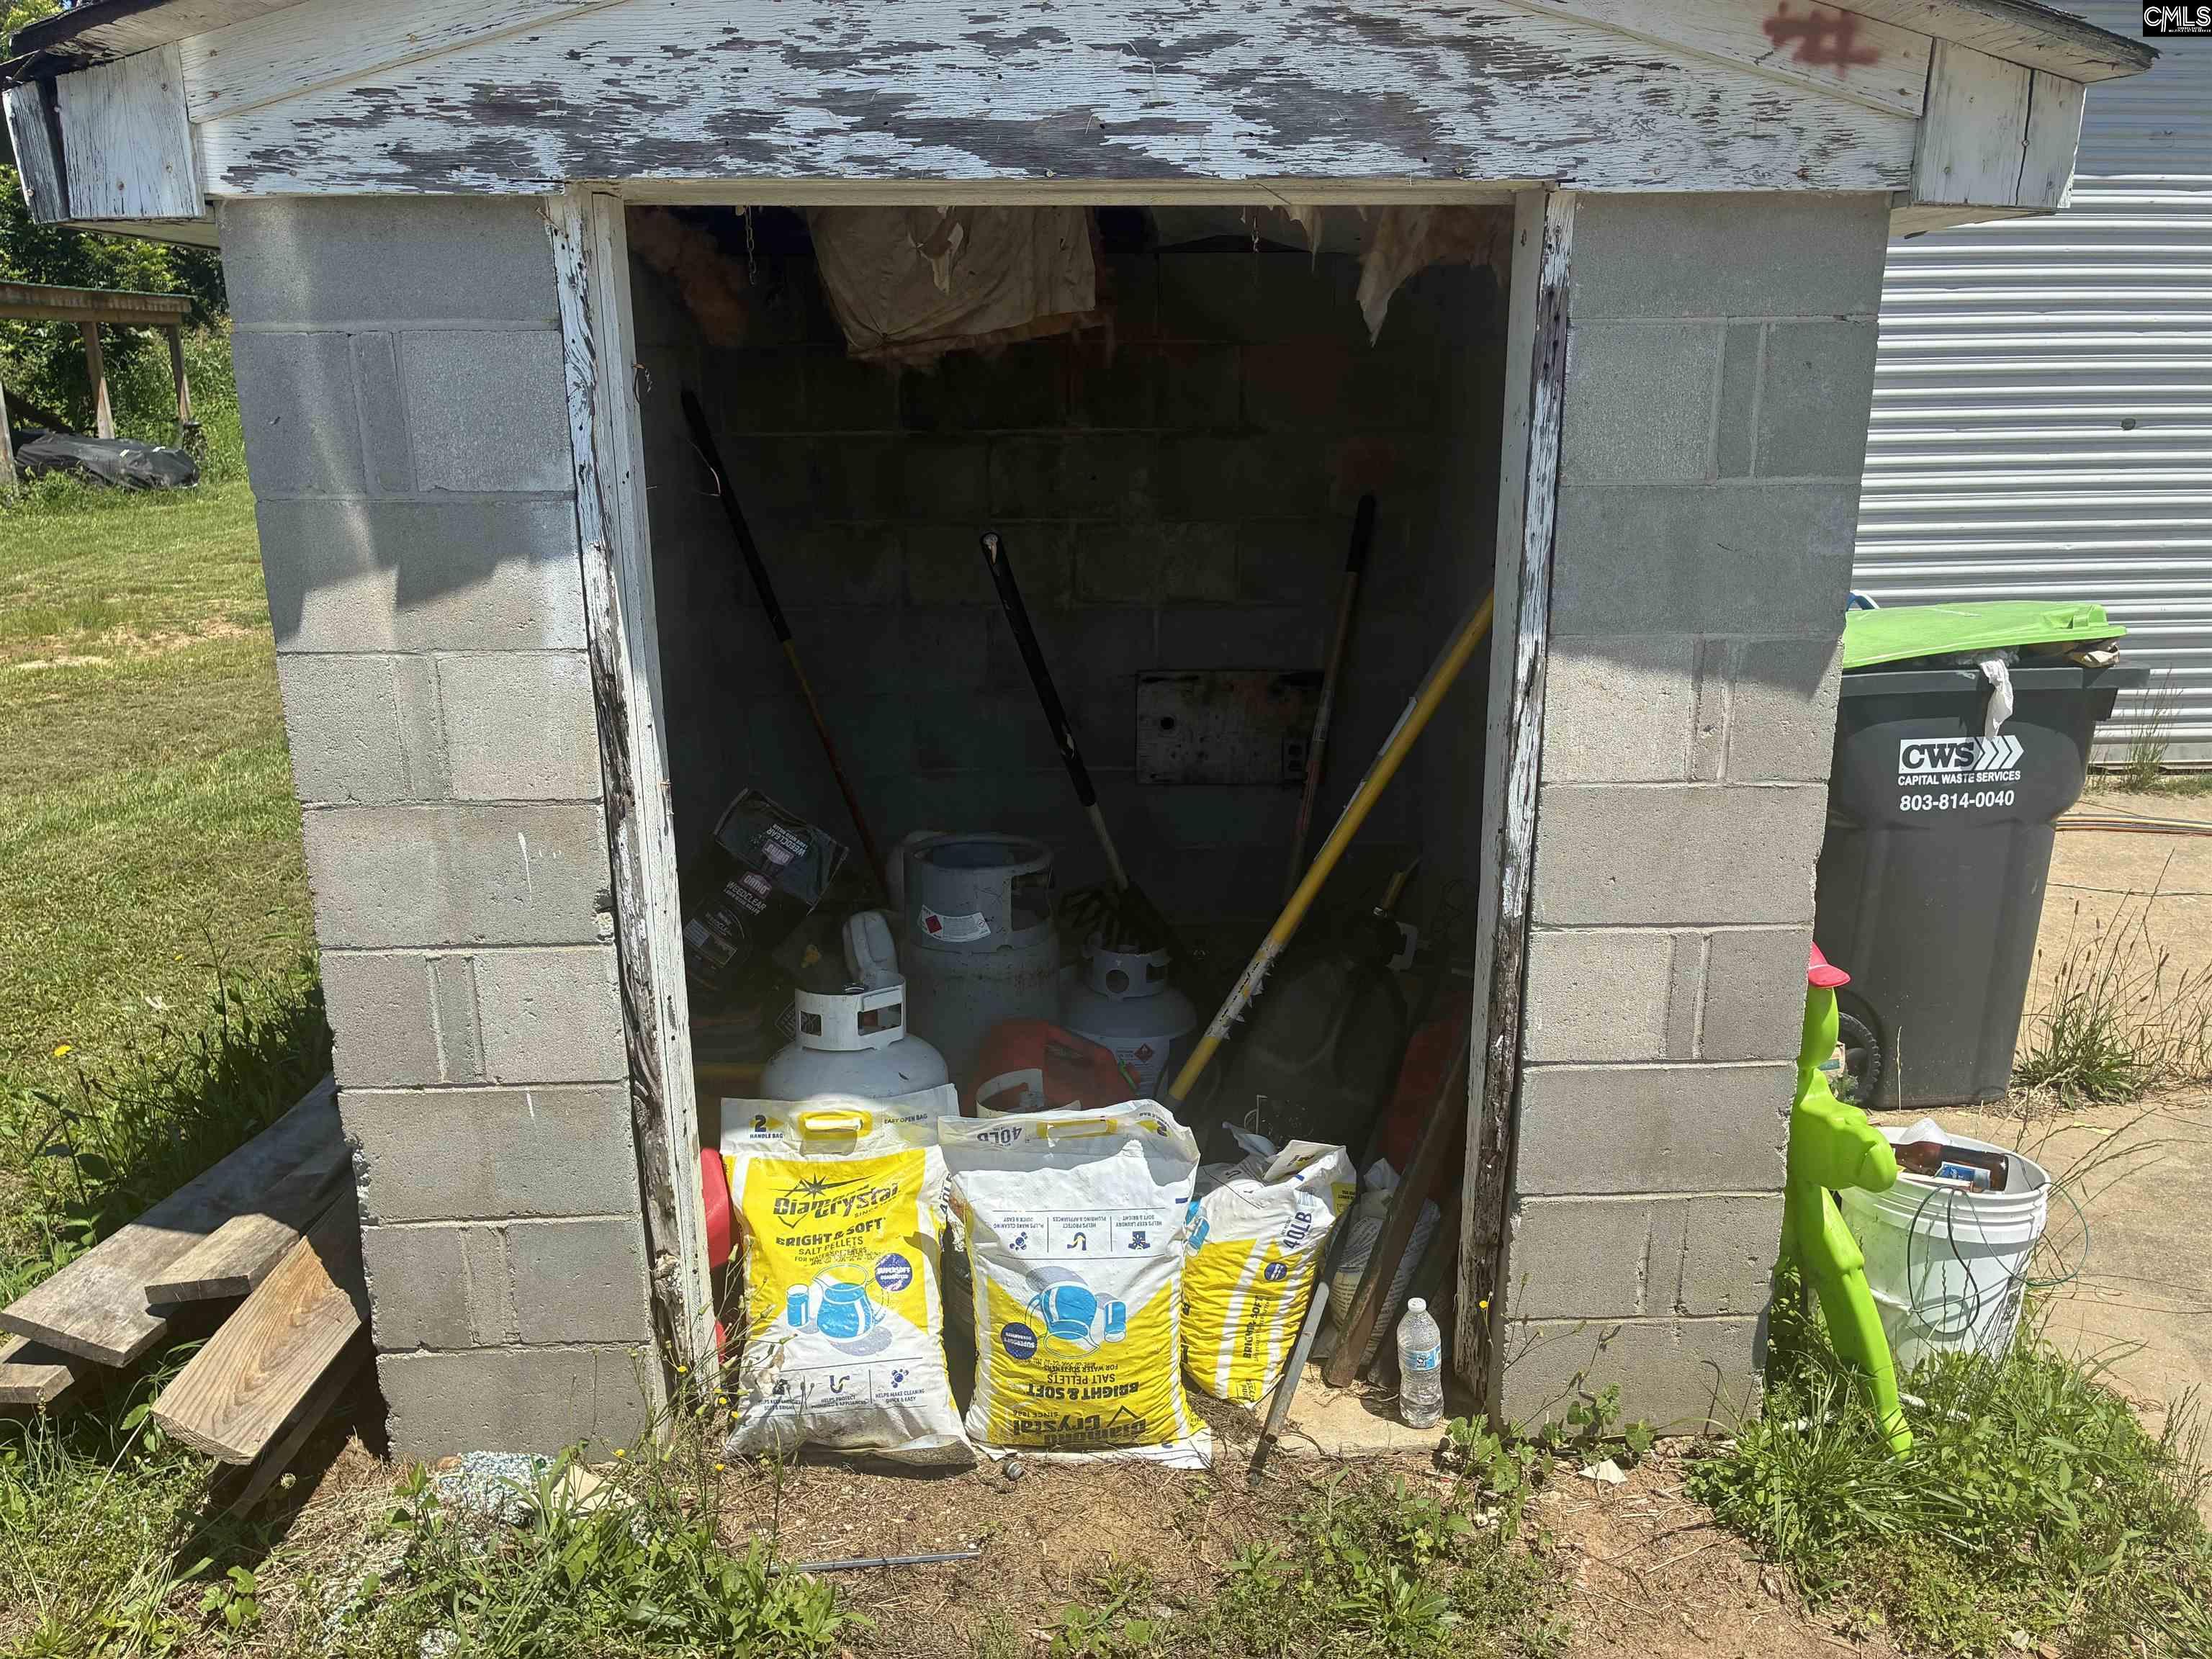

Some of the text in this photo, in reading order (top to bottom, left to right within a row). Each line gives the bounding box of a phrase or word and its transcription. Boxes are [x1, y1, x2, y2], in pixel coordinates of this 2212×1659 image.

[1902, 741, 1975, 770] CWS
[1898, 770, 2021, 786] CAPITAL WASTE SERVICES
[1899, 790, 2014, 811] 803-814-0040
[755, 1115, 767, 1133] 2
[775, 1218, 882, 1246] BRIGHT & SOFT
[1283, 1210, 1313, 1251] 40LB
[824, 1236, 864, 1251] PELLETS
[1250, 1295, 1263, 1319] SOFT
[1047, 1373, 1115, 1385] SALT PELLETS
[1026, 1381, 1139, 1401] BRIGHT & SOFT
[1012, 1414, 1101, 1436] Crystal
